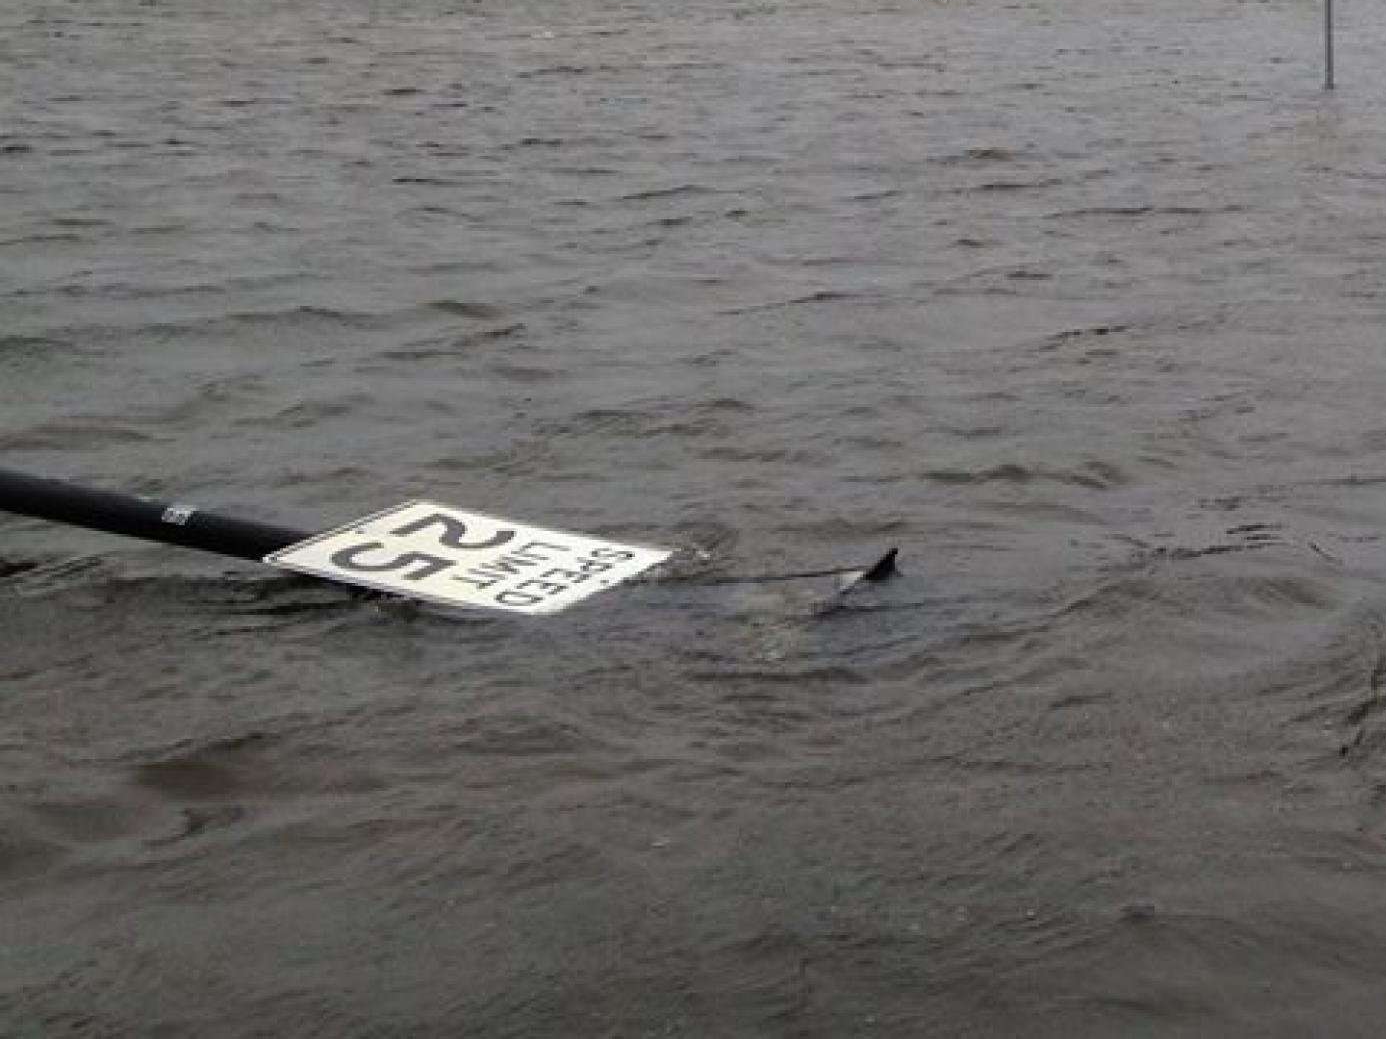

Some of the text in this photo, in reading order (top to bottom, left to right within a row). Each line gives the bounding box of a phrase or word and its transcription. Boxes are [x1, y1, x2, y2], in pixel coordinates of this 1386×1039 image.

[330, 513, 516, 580] 25
[452, 542, 571, 589] LIMIT
[494, 548, 635, 606] SPEED
